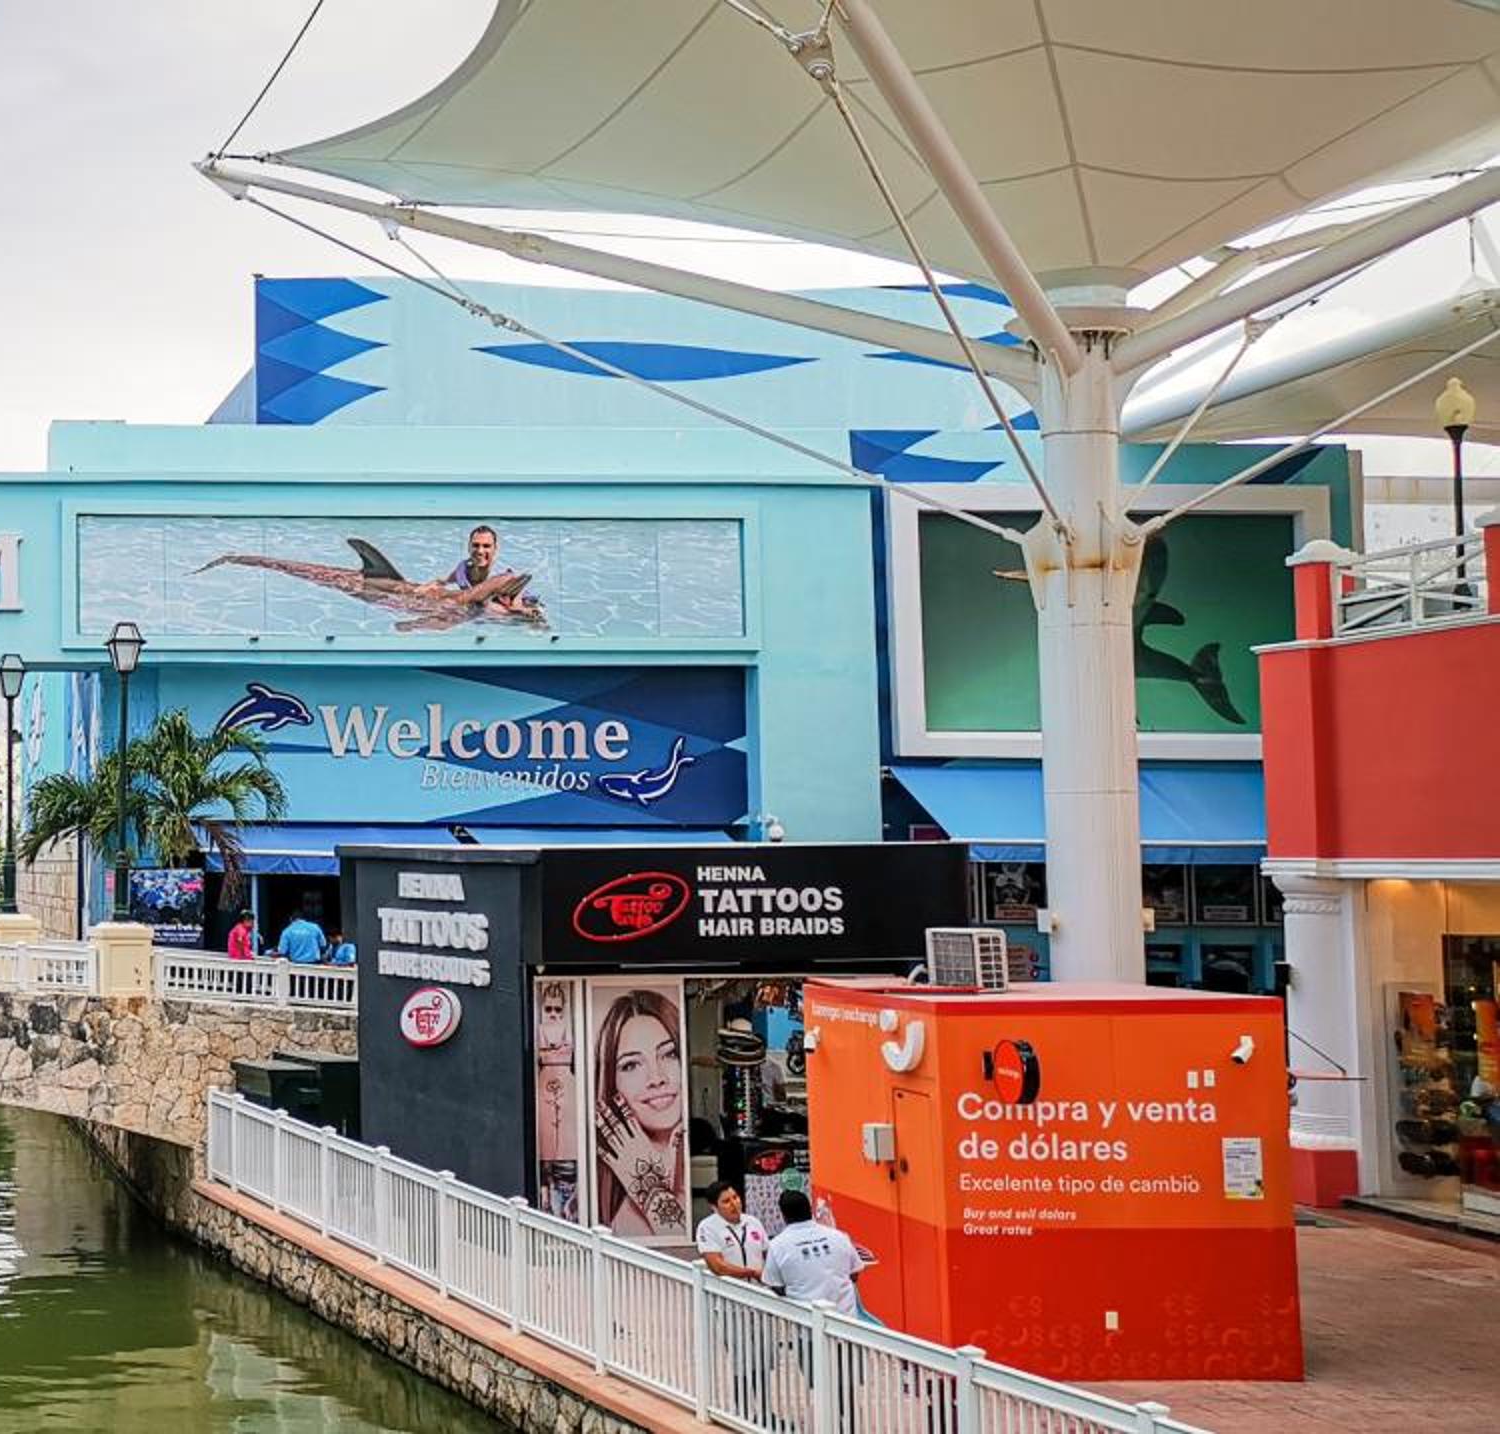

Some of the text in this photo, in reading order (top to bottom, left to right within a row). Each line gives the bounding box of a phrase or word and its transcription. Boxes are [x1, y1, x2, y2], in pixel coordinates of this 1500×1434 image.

[318, 703, 630, 760] Welcome
[420, 762, 591, 790] Bienvenidos
[398, 872, 465, 900] HENNA
[697, 866, 767, 881] HENNA
[698, 887, 844, 914] TATTOOS
[377, 907, 489, 951] TATTOOS
[699, 917, 845, 936] HAIR BRAIDS
[957, 1092, 1218, 1129] Compra y venta
[958, 1131, 1129, 1162] de dólares
[960, 1173, 1200, 1195] Excelente tipo de cambio
[963, 1207, 986, 1221] Buy
[988, 1208, 1013, 1219] and
[1015, 1208, 1037, 1220] sell
[963, 1222, 1034, 1236] Great rates
